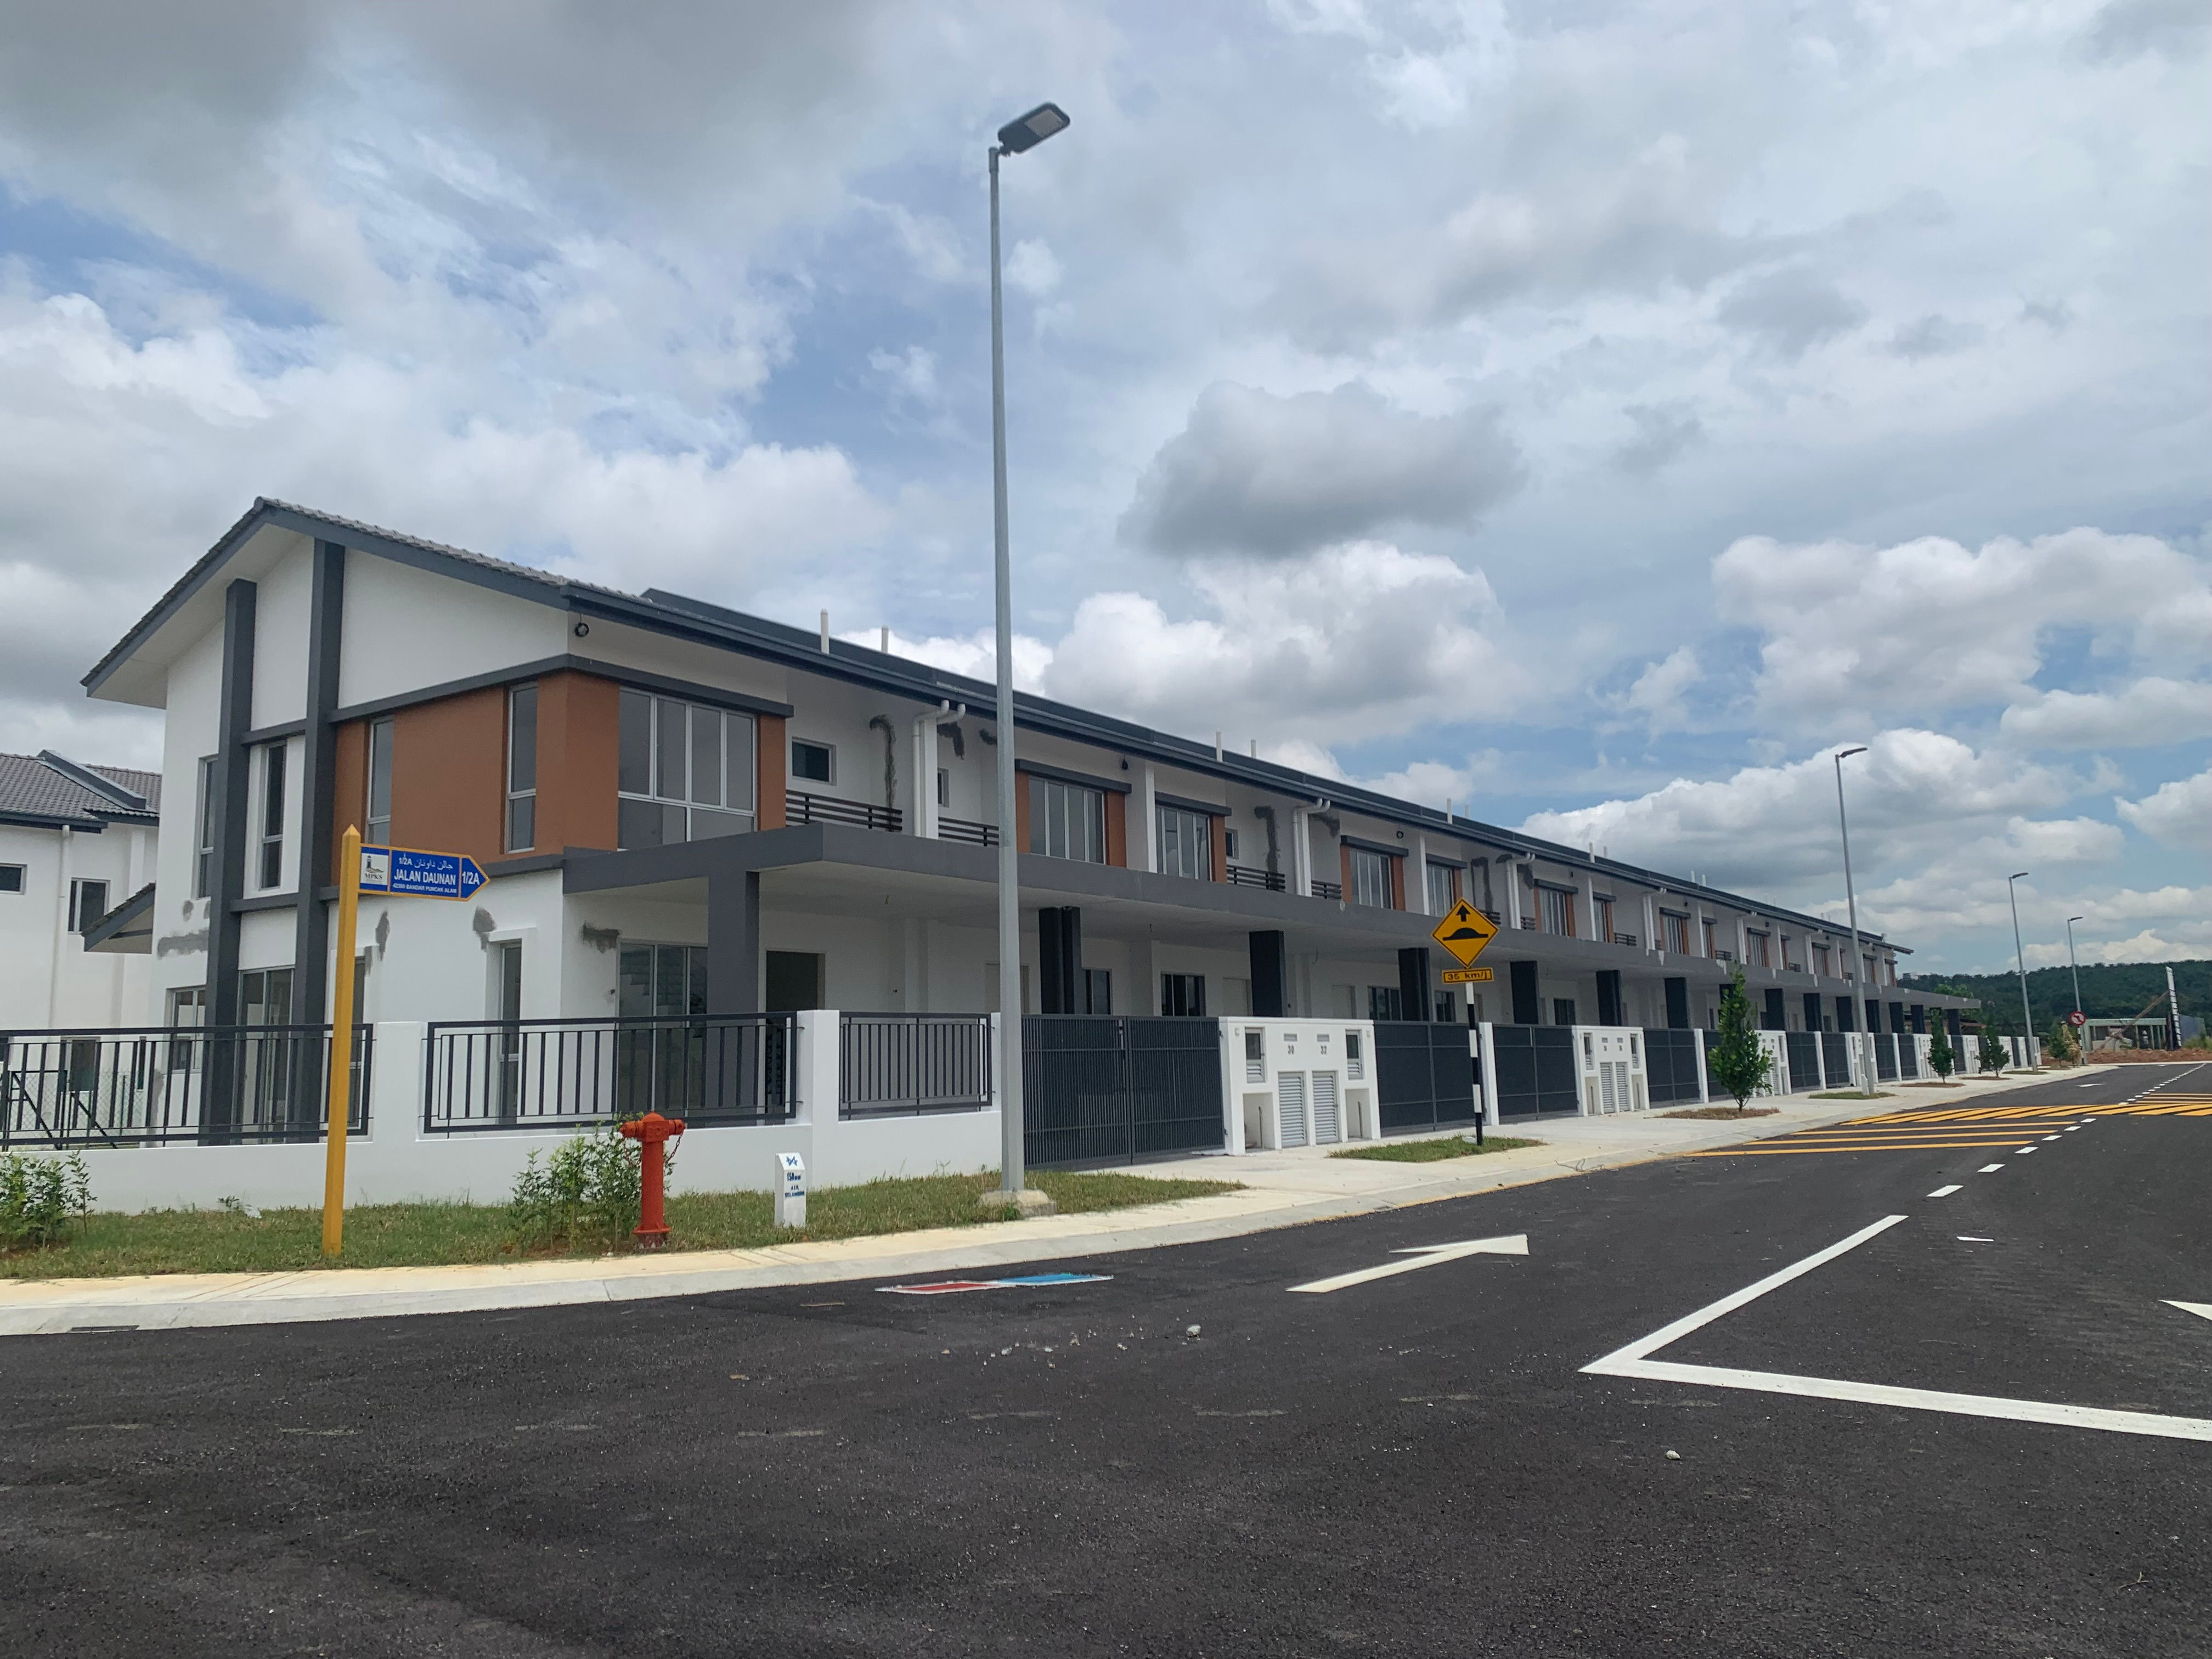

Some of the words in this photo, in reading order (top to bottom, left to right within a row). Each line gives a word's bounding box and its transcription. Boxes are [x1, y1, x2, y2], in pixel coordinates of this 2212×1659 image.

[394, 869, 421, 882] JALAN
[423, 872, 456, 885] DAUNAN
[462, 871, 479, 885] 1/2A
[1288, 1045, 1295, 1054] 30
[1321, 1045, 1327, 1054] 32
